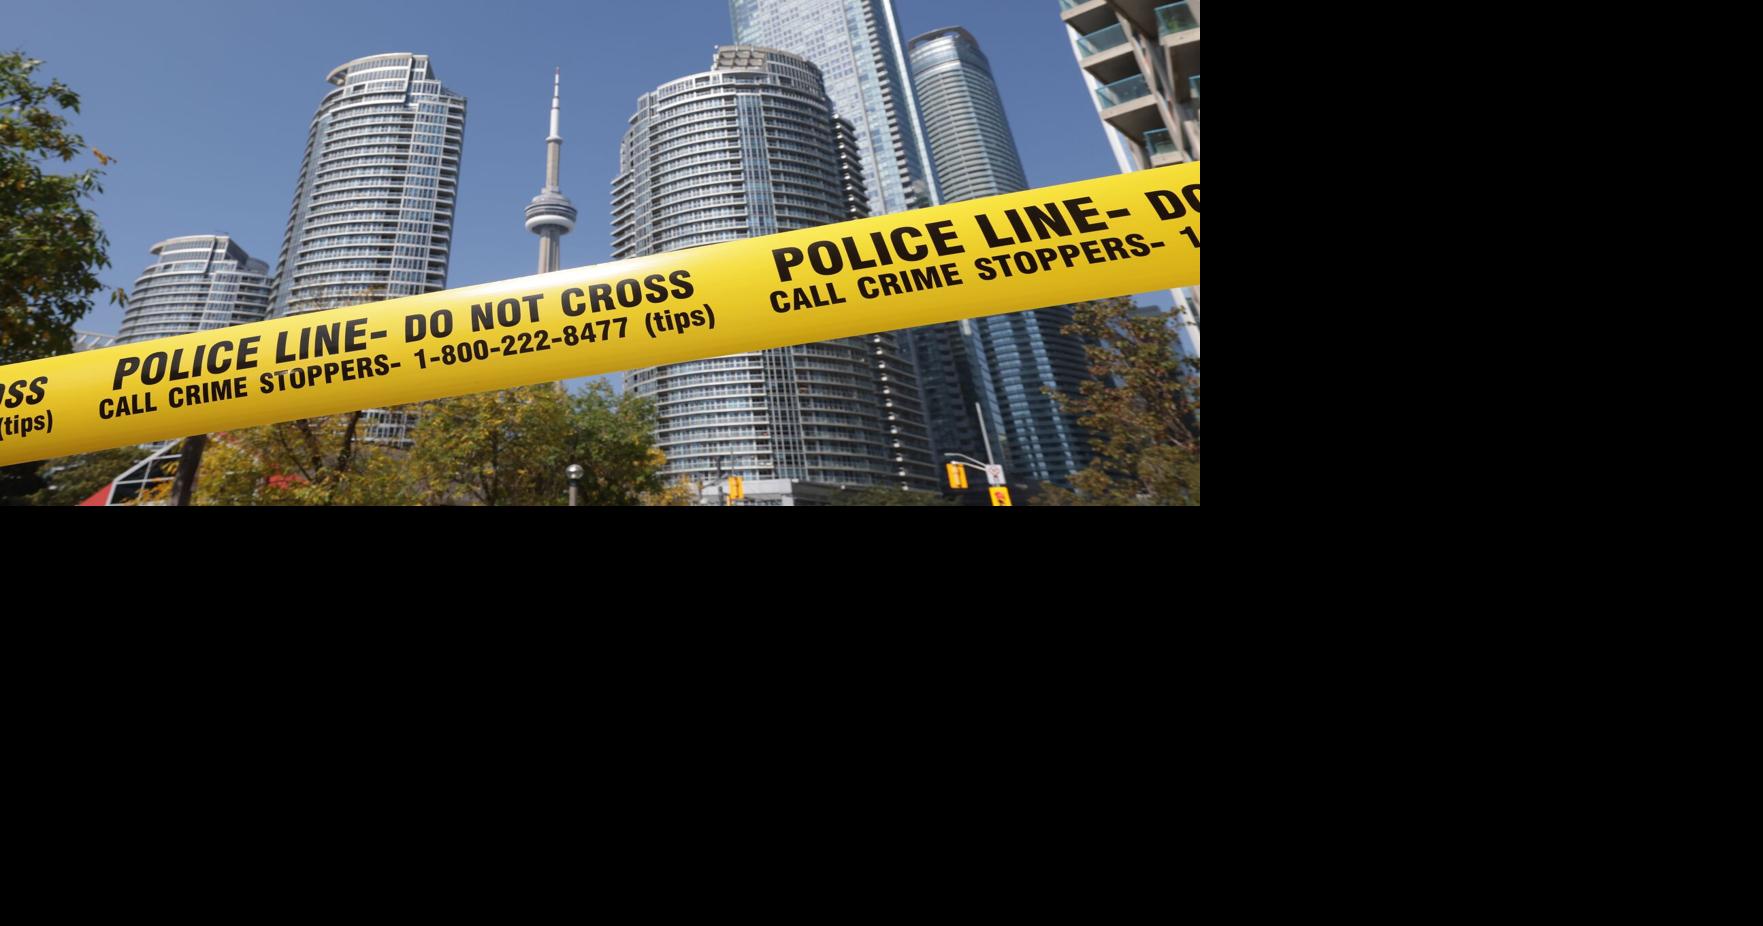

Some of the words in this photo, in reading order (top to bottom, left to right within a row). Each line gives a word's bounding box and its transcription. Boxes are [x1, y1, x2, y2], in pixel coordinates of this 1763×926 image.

[769, 282, 847, 314] CALL
[857, 262, 964, 300] CRIME
[974, 233, 1166, 281] STOPPERS-
[771, 219, 966, 283] POLICE
[974, 196, 1131, 249] LINE-
[98, 391, 158, 420] CALL
[168, 376, 248, 409] CRIME
[259, 353, 401, 395] STOPPERS-
[414, 316, 628, 370] 1-800-222-8477
[644, 303, 715, 339] (tips)
[112, 335, 261, 391] POLICE
[275, 317, 387, 364] LINE-
[404, 309, 453, 344] DO
[471, 293, 544, 333] NOT
[561, 269, 695, 317] CROSS
[0, 376, 49, 409] SS
